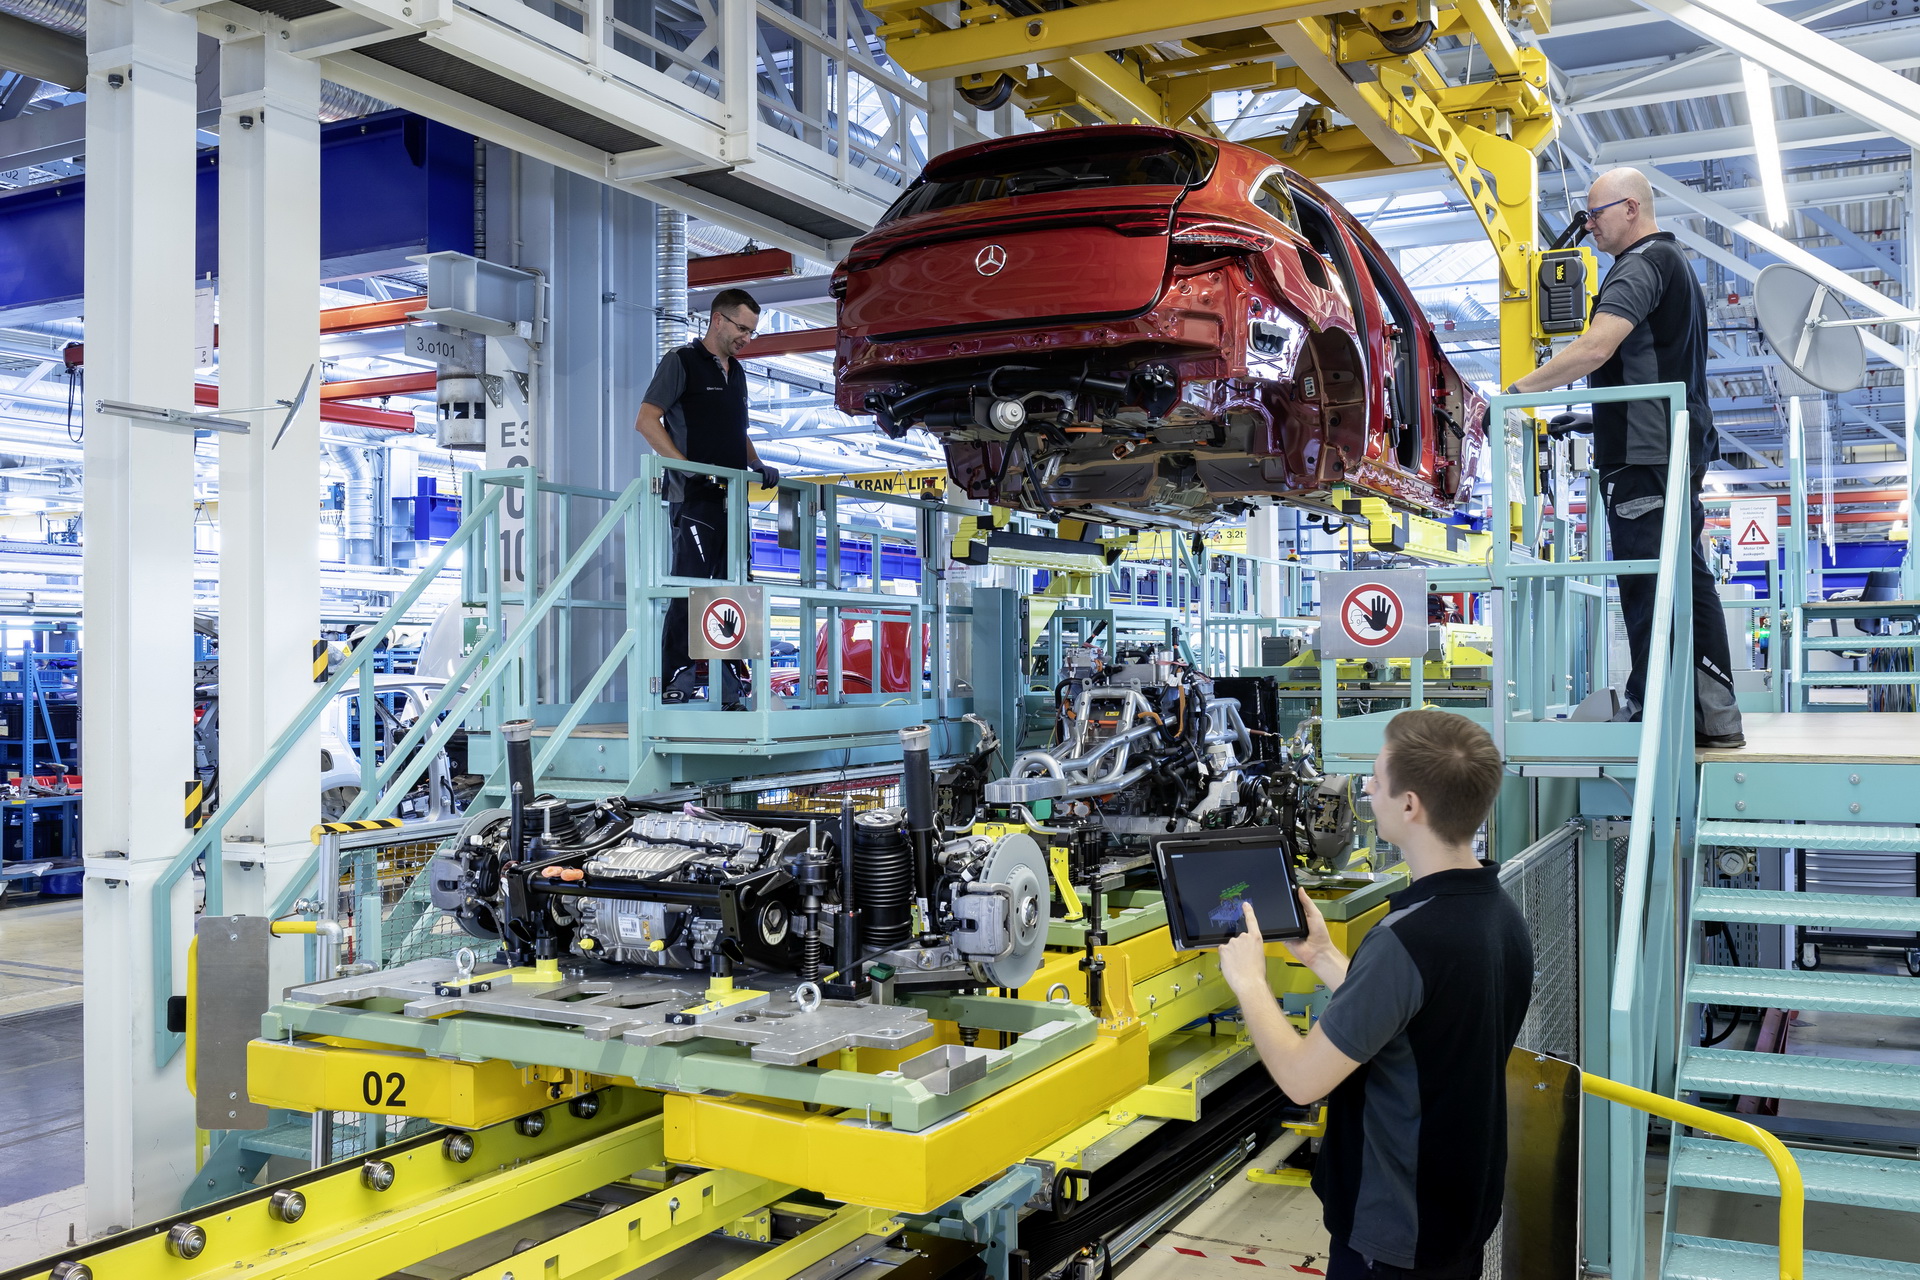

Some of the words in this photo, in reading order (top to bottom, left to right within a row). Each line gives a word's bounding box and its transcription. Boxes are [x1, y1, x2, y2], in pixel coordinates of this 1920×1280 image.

[1556, 264, 1565, 280] Yale
[854, 478, 893, 491] KRAN
[363, 1070, 407, 1107] 02
